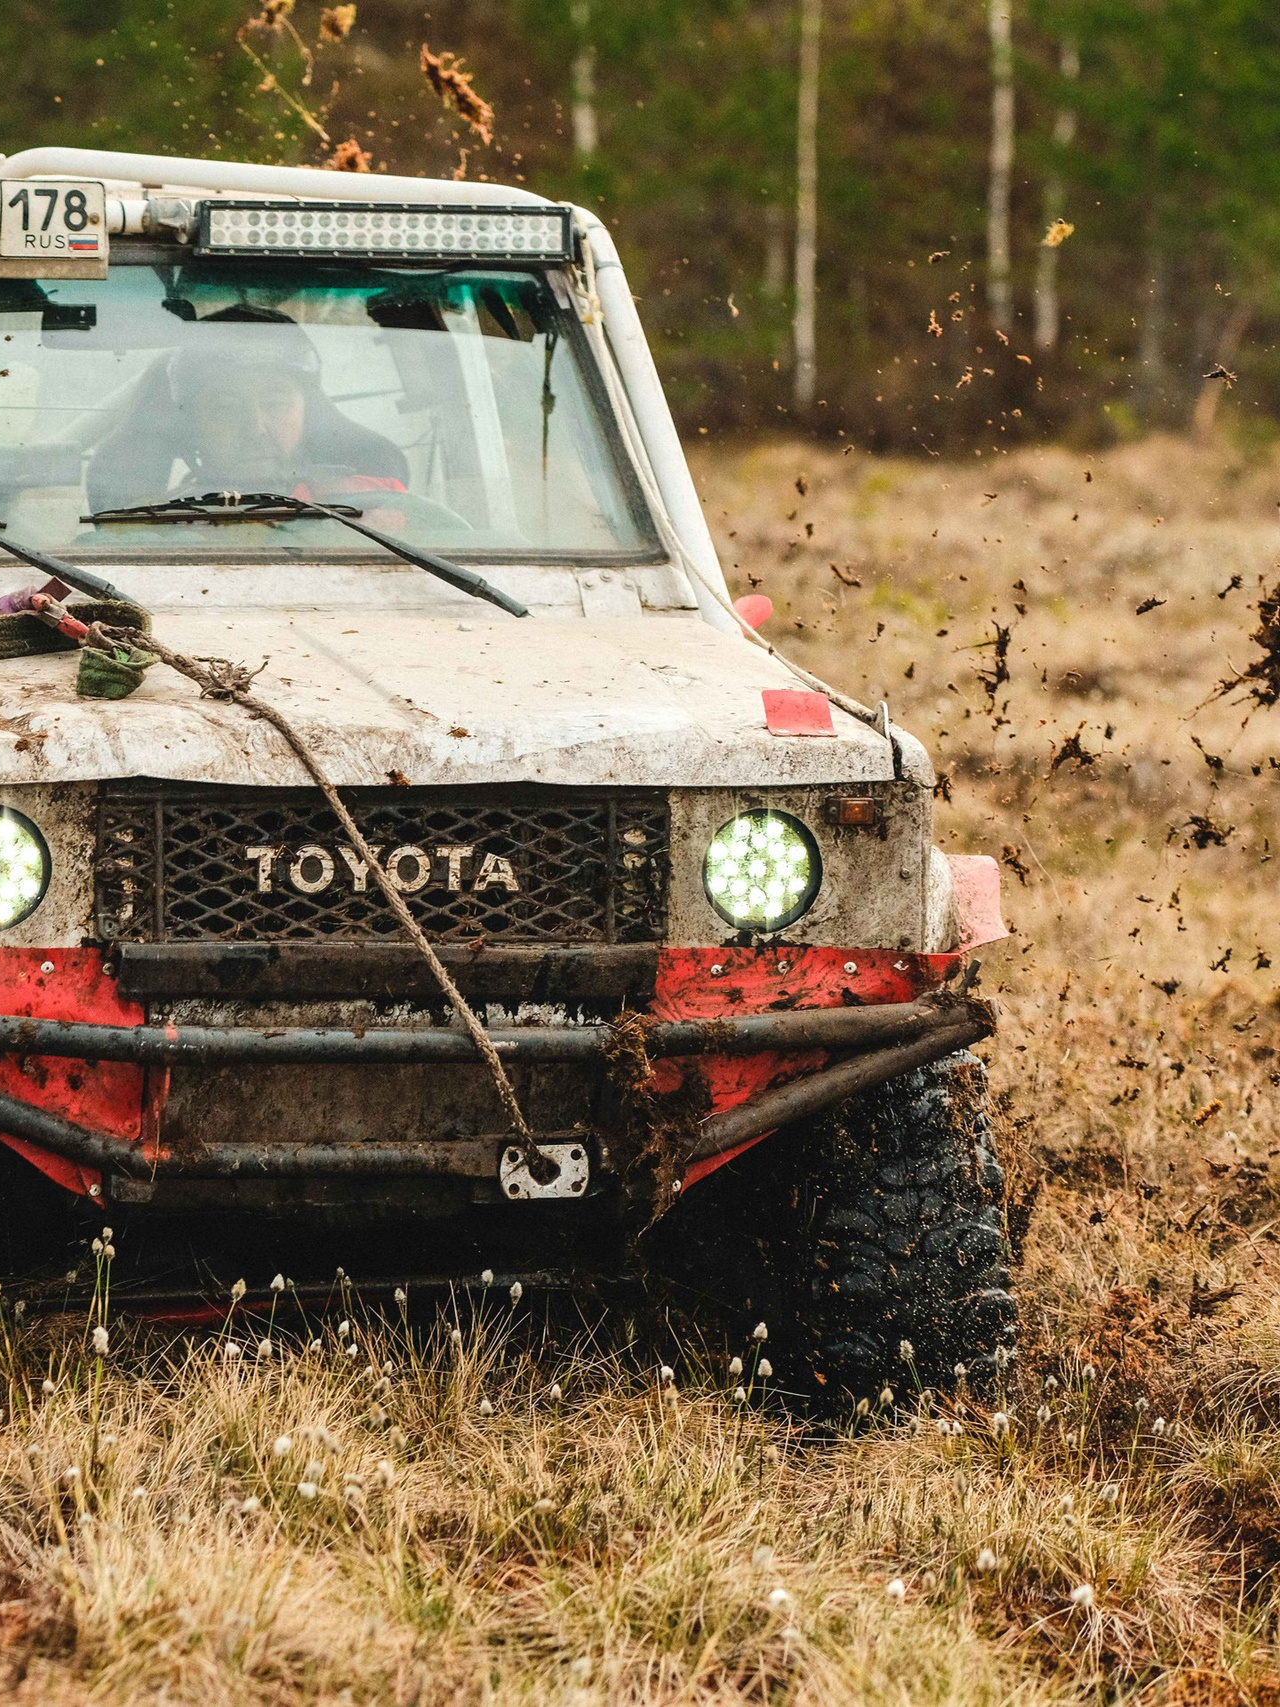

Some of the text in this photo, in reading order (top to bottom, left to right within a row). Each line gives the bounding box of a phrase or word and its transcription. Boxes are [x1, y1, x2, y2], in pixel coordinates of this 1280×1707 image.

[7, 188, 89, 232] 178
[24, 233, 66, 249] RUS
[244, 845, 520, 894] TOYOTA
